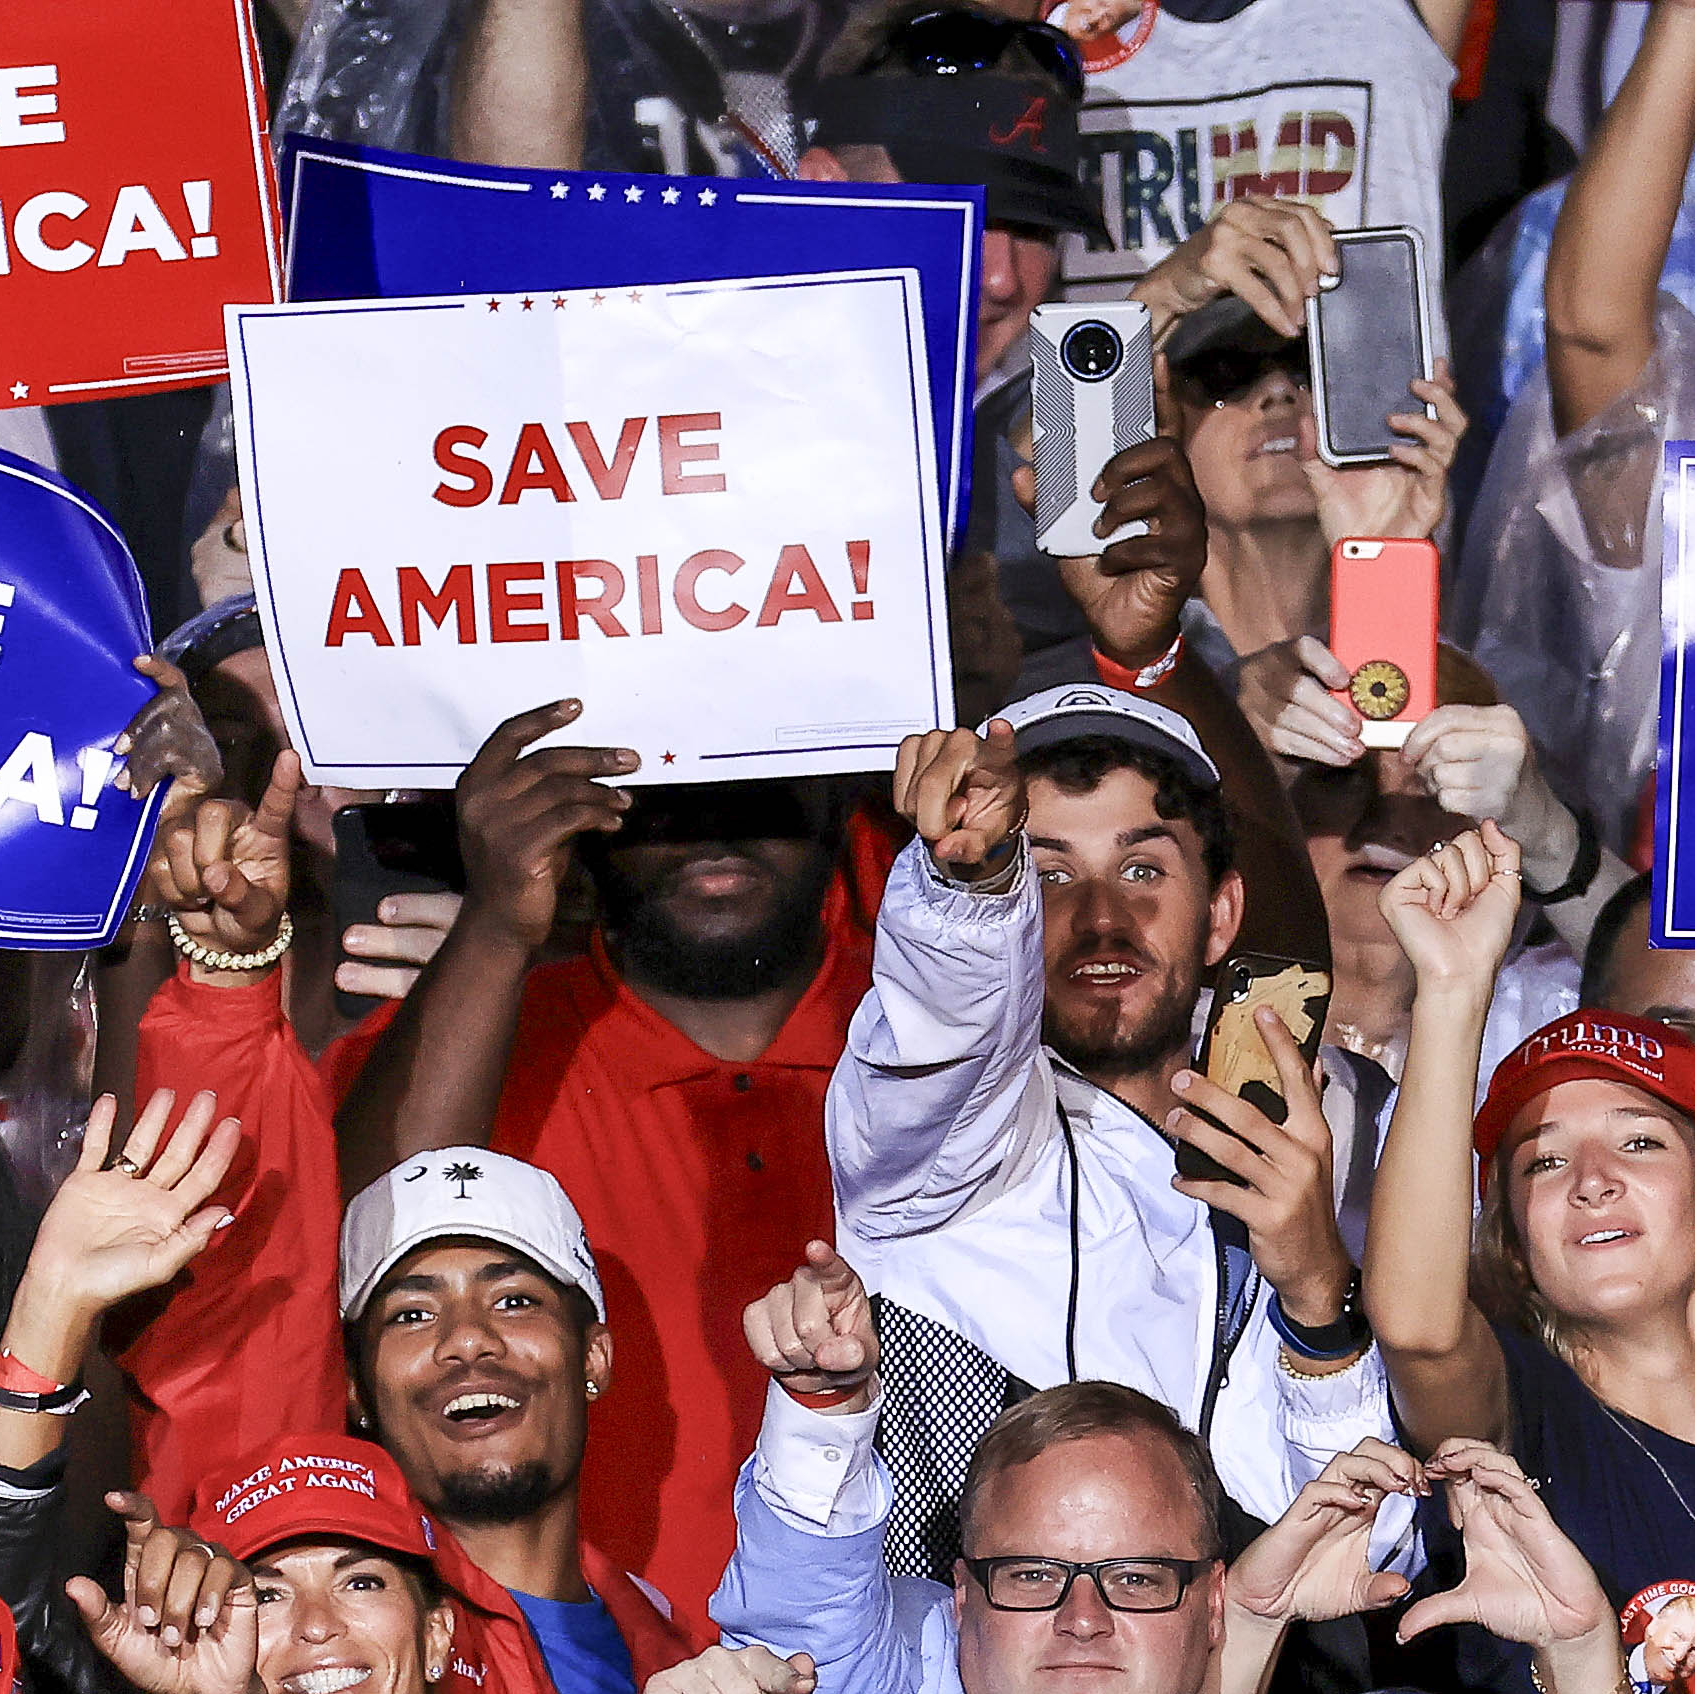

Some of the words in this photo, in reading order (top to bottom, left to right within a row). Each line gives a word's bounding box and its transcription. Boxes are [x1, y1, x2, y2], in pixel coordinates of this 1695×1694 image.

[1077, 110, 1359, 251] TRUMP
[432, 411, 726, 508] SAVE
[326, 539, 876, 648] AMERICA!
[215, 1466, 272, 1512] MAKE
[280, 1455, 376, 1486] AMERICA
[225, 1477, 295, 1524] GREAT
[305, 1474, 376, 1499] AGAIN
[1637, 1585, 1667, 1604] TIME
